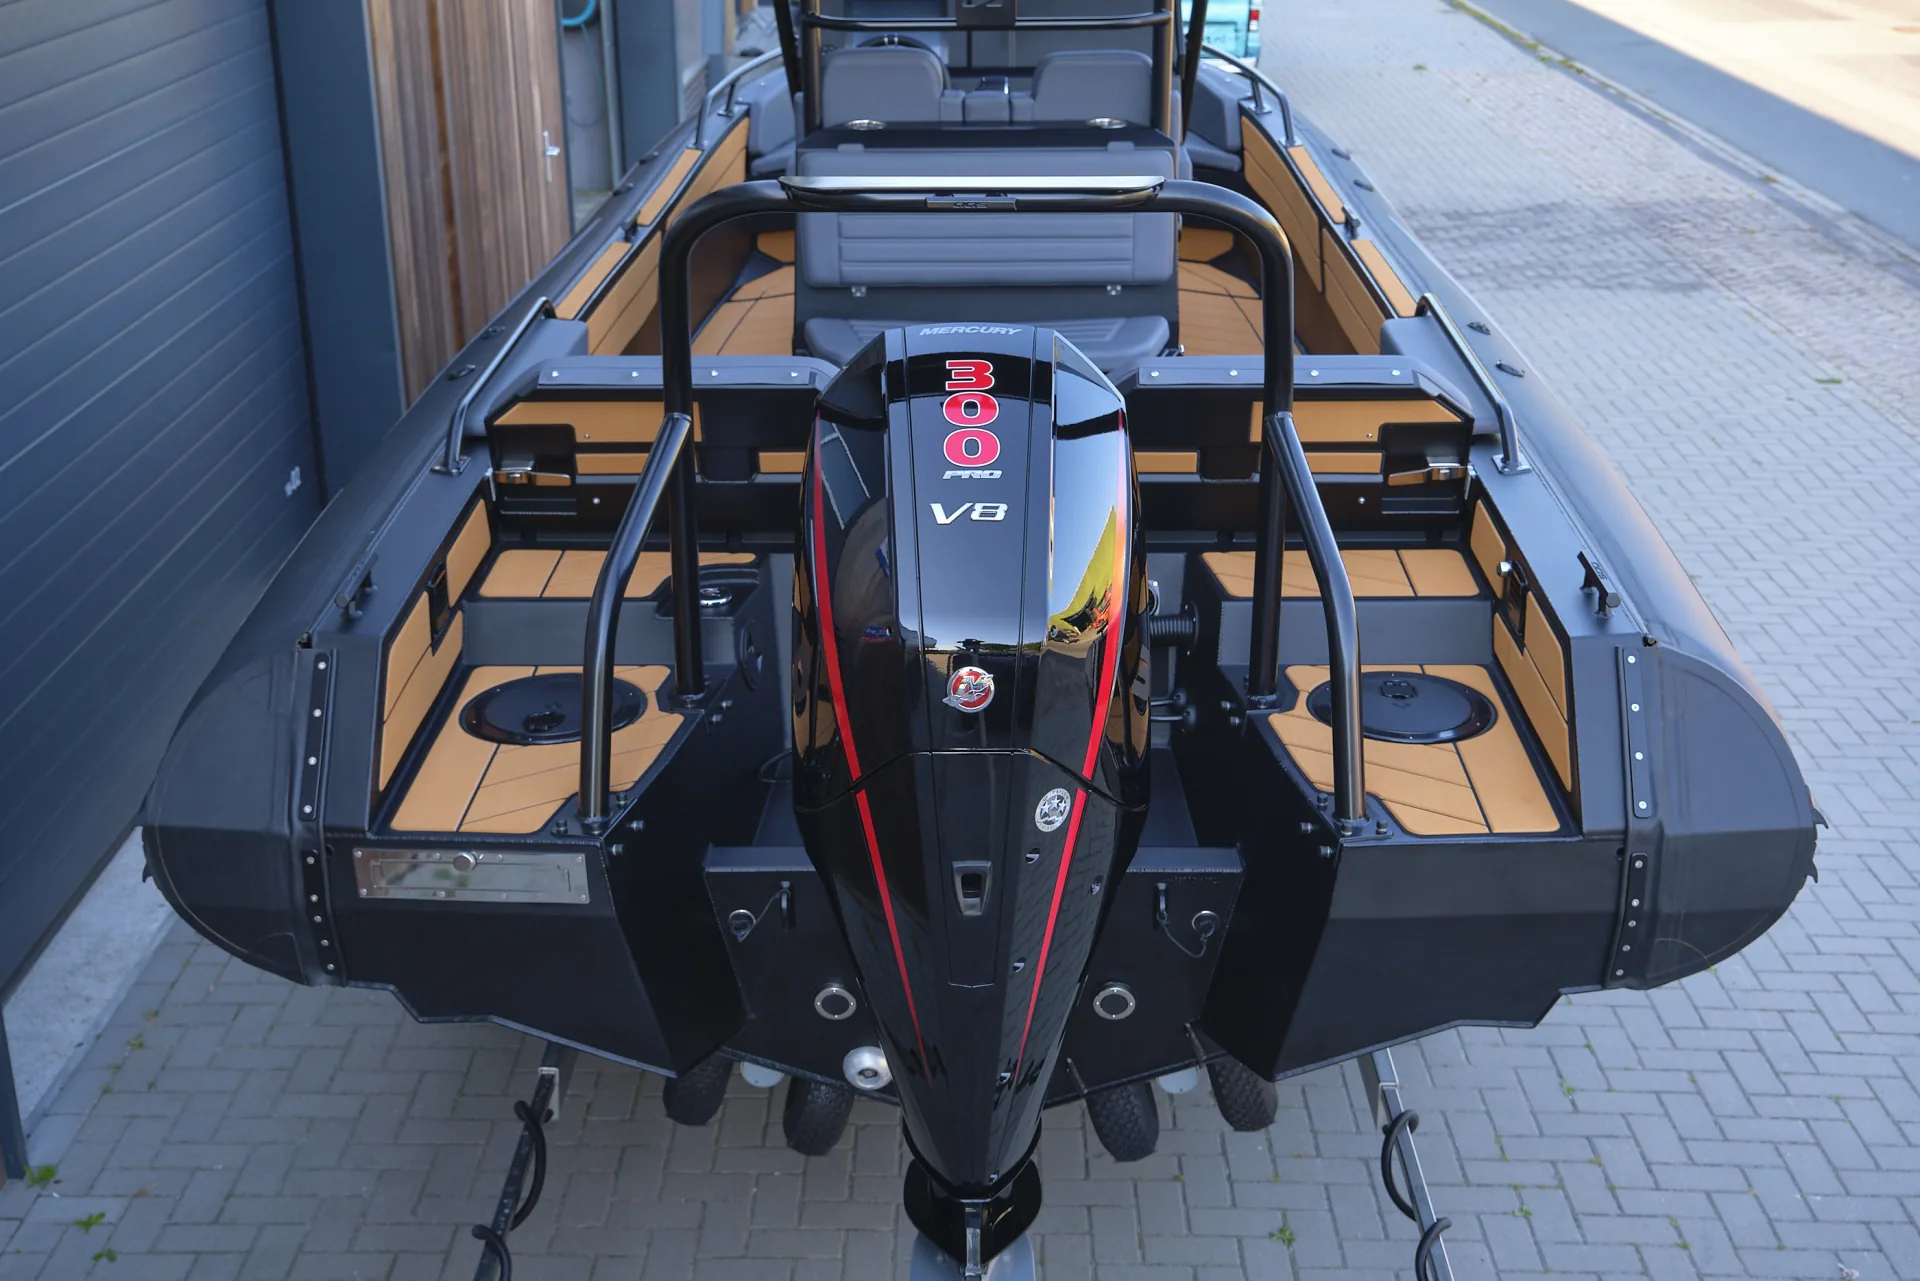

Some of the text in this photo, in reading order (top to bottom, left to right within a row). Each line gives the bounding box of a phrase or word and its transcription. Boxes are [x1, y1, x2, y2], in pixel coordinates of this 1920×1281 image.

[919, 326, 1022, 336] MERCURY
[943, 360, 1000, 467] 300
[942, 470, 1003, 479] PRO
[930, 502, 1008, 525] V8
